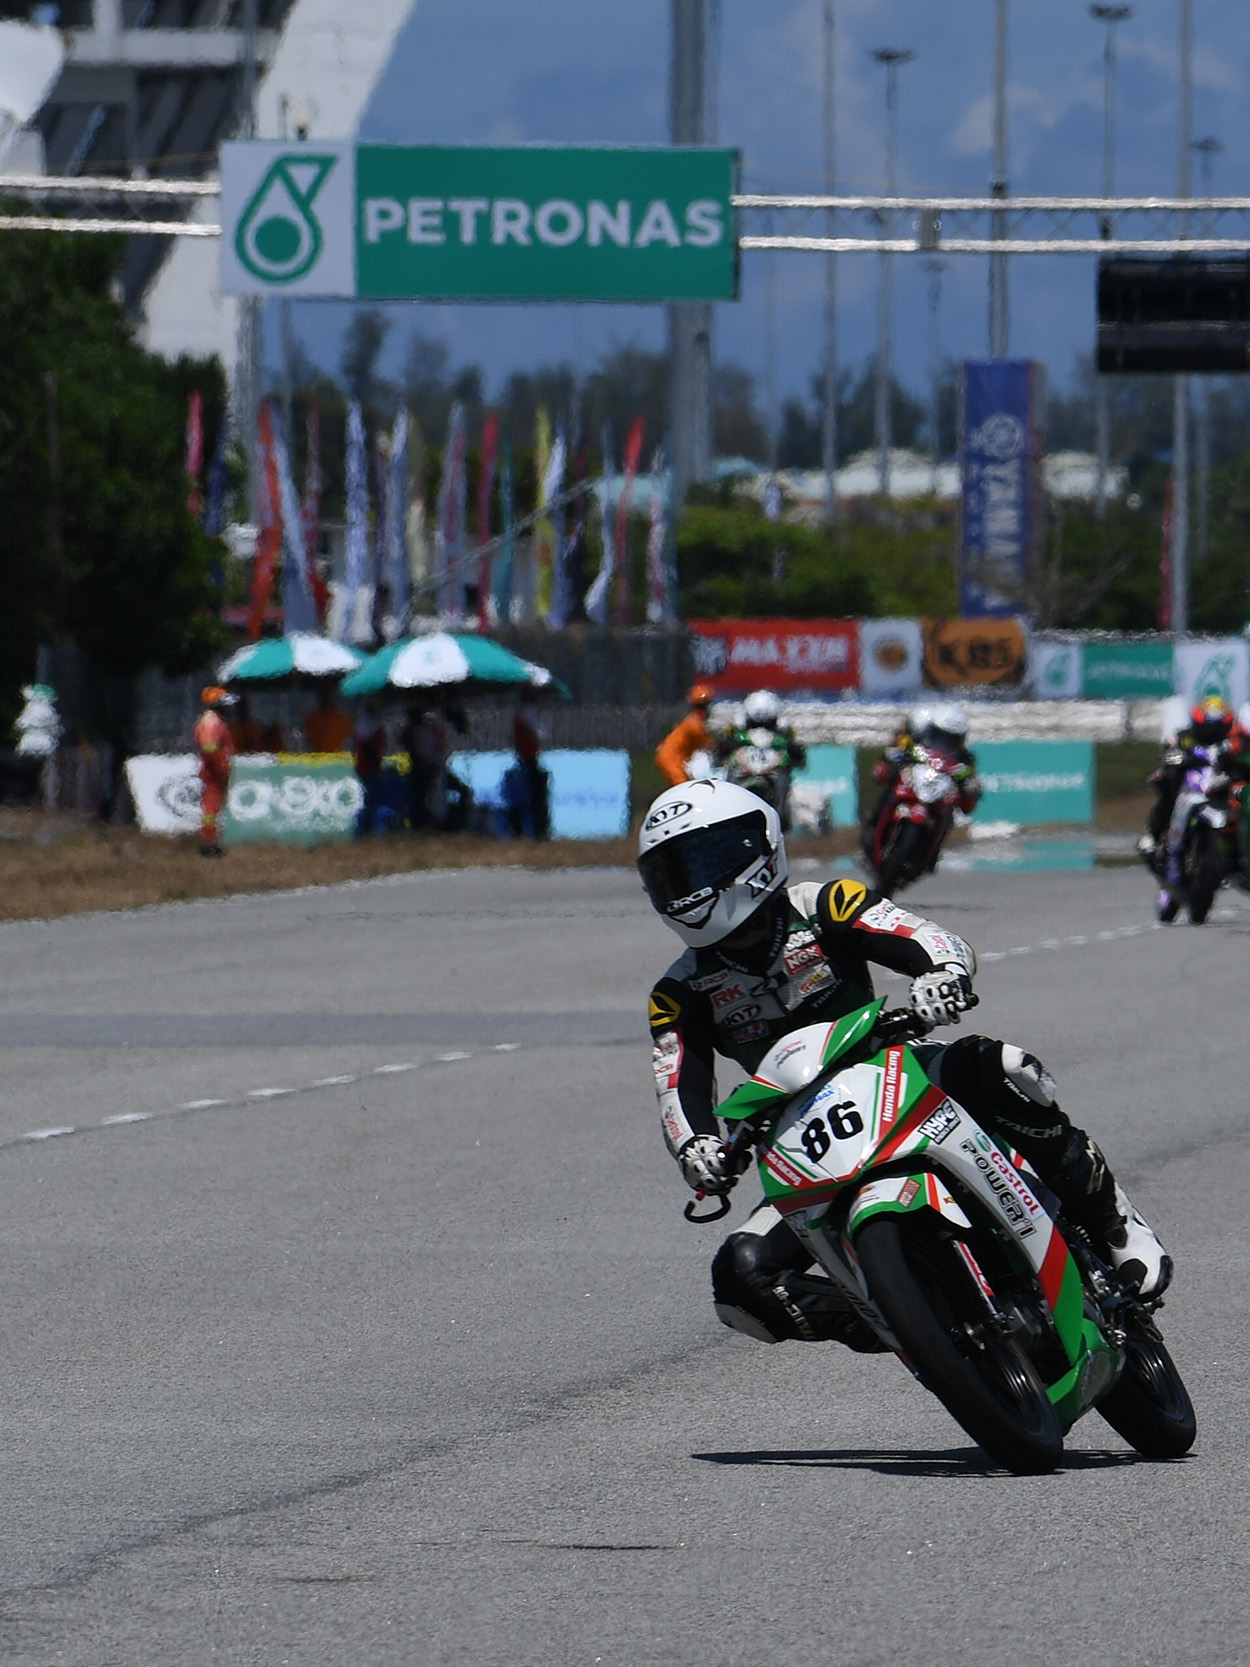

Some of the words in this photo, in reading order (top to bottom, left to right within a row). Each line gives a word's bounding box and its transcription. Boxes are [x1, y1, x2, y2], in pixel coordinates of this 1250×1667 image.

[363, 197, 724, 248] PETRONAS
[786, 946, 821, 970] NGK
[711, 983, 747, 1008] RK
[886, 1050, 901, 1084] Racing
[882, 1085, 896, 1122] Honda
[919, 1099, 957, 1140] HYPE
[801, 1101, 864, 1164] 86
[990, 1151, 1040, 1216] Castrol
